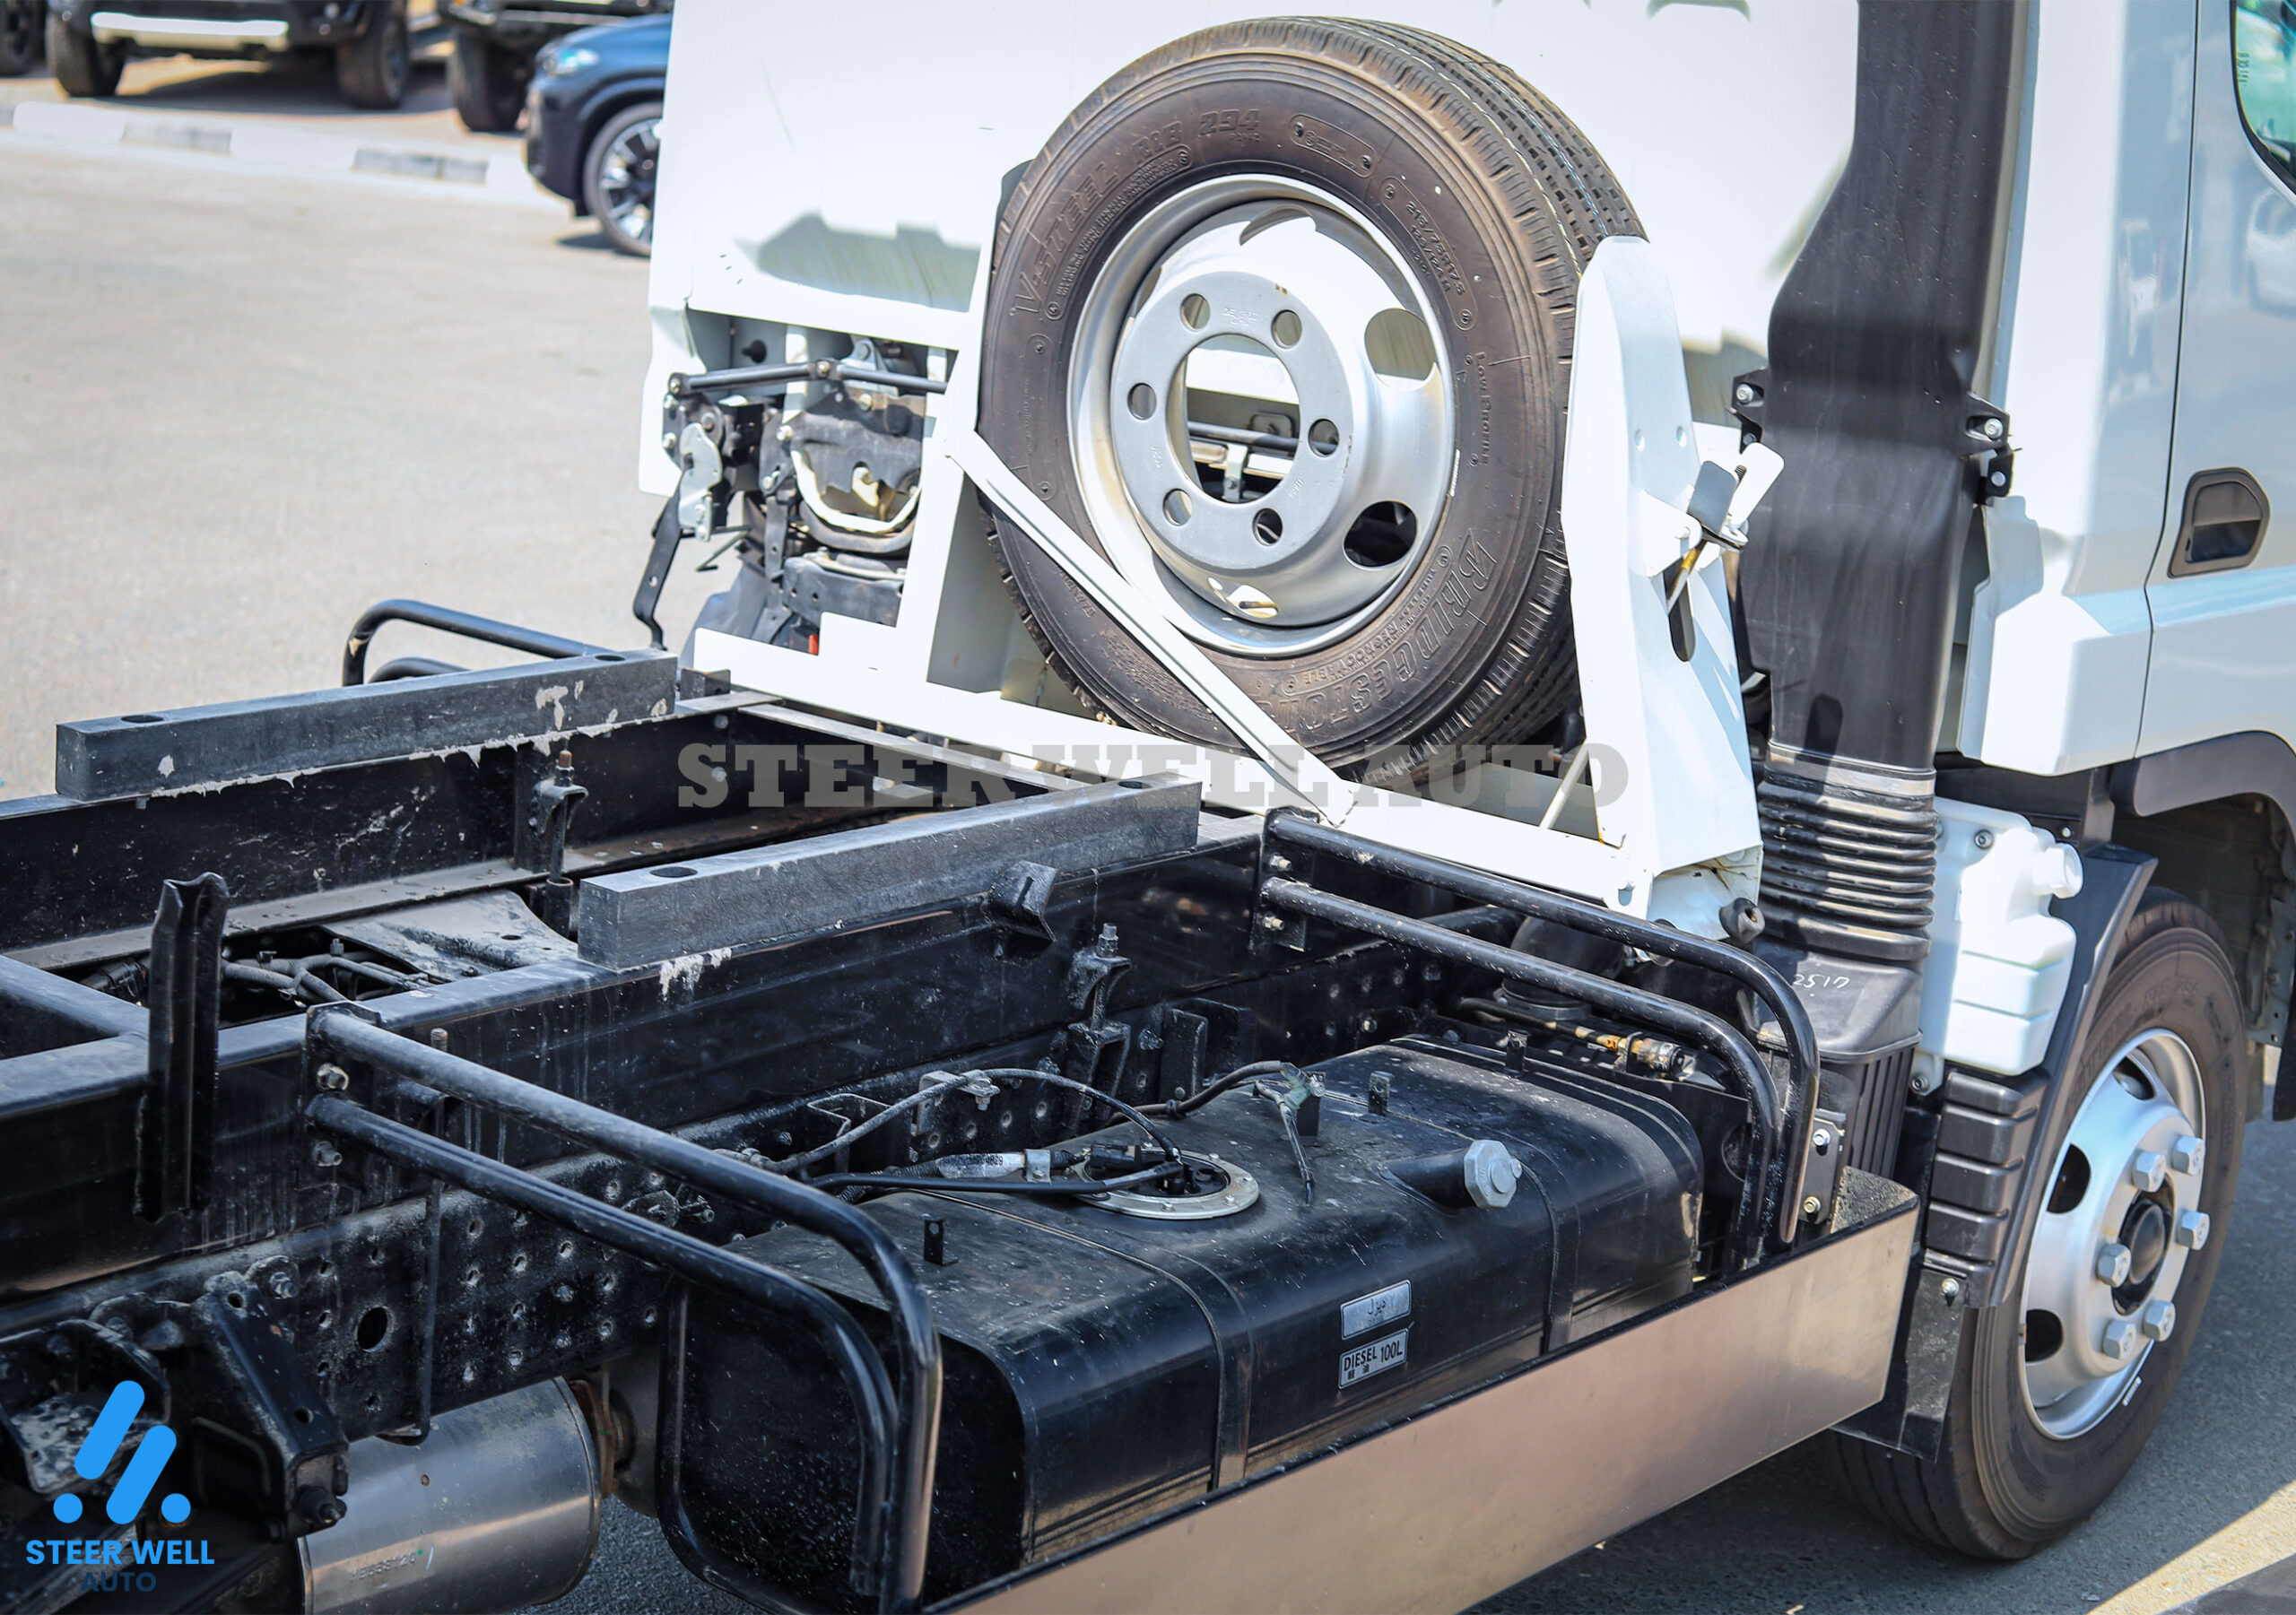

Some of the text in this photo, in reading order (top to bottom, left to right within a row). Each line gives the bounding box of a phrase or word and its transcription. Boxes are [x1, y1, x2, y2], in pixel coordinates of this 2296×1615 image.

[1200, 109, 1260, 135] 294
[1344, 1340, 1403, 1372] DIESEL 100L
